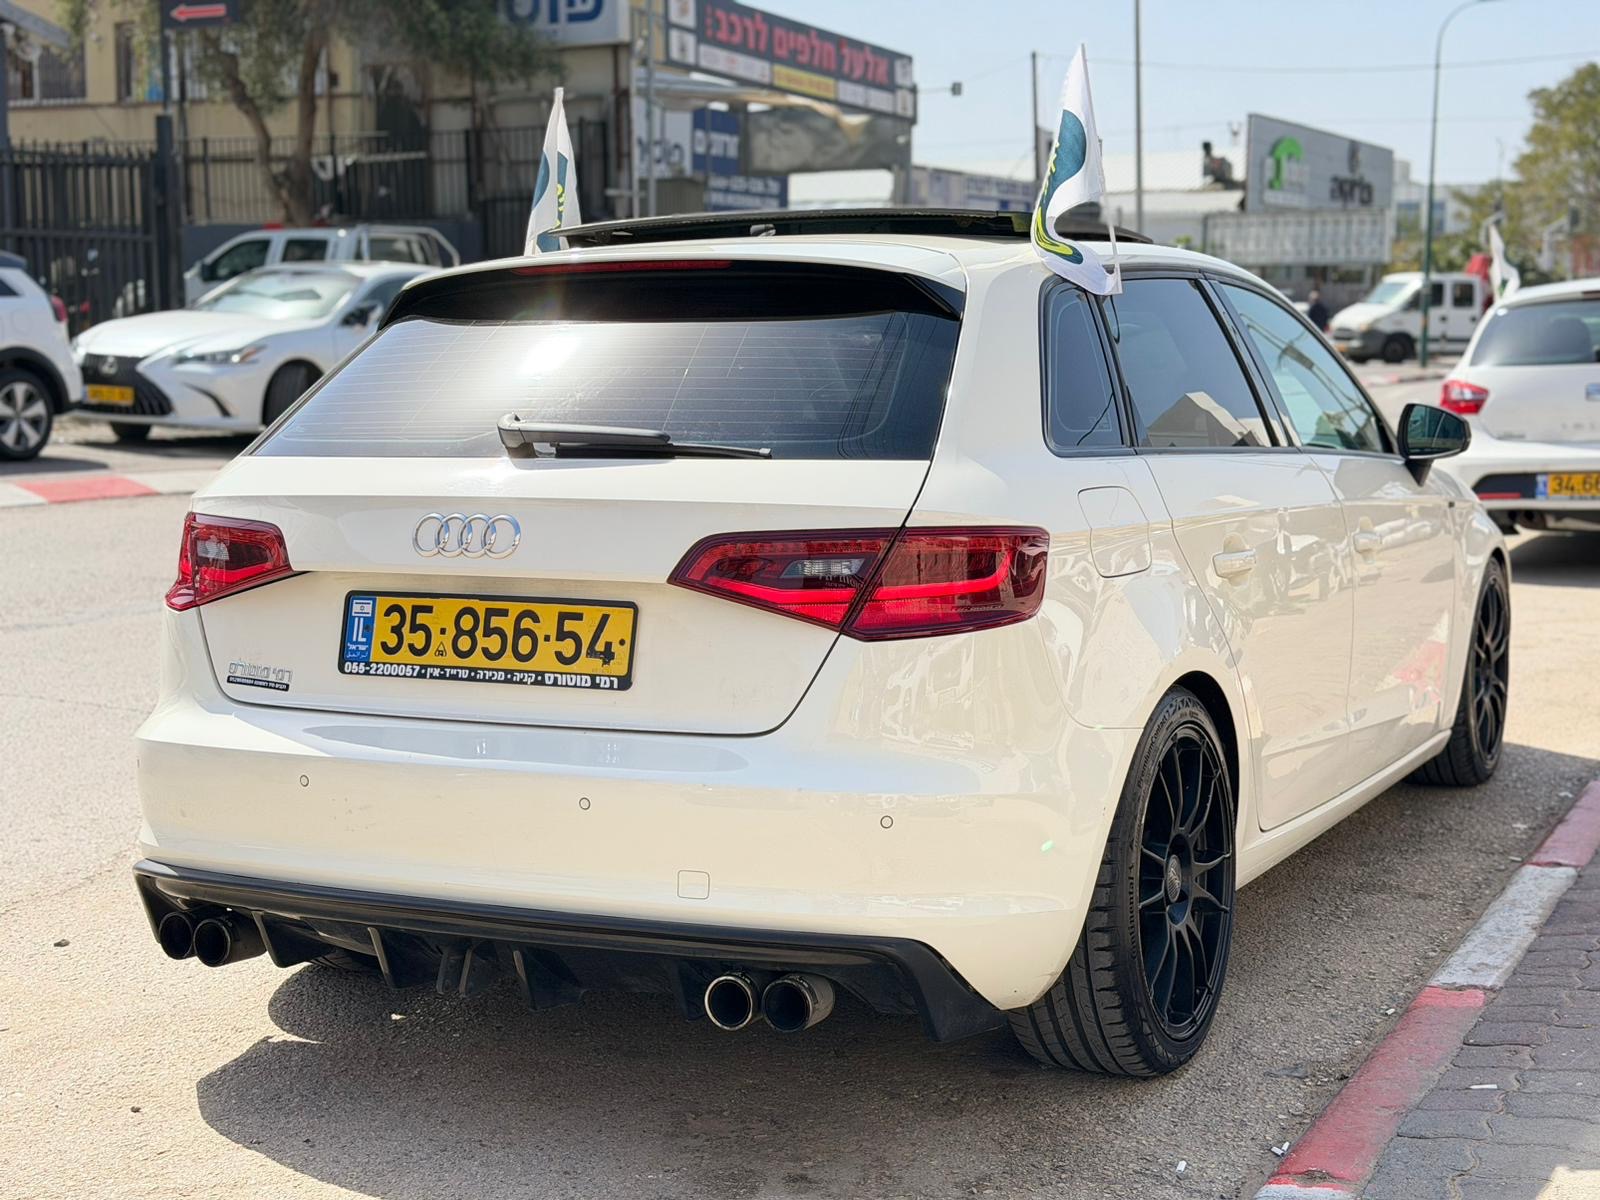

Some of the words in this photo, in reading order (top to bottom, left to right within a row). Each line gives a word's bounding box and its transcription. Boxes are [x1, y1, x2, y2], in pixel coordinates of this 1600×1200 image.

[773, 27, 836, 71] חלפים
[352, 617, 367, 642] IL
[344, 661, 421, 677] 055-2200057
[426, 666, 469, 679] טרייד-אין
[476, 669, 505, 681] מכירה
[512, 671, 536, 685] קניה
[544, 673, 592, 687] מוטורס
[595, 675, 619, 689] רמי
[1127, 876, 1138, 960] Continental
